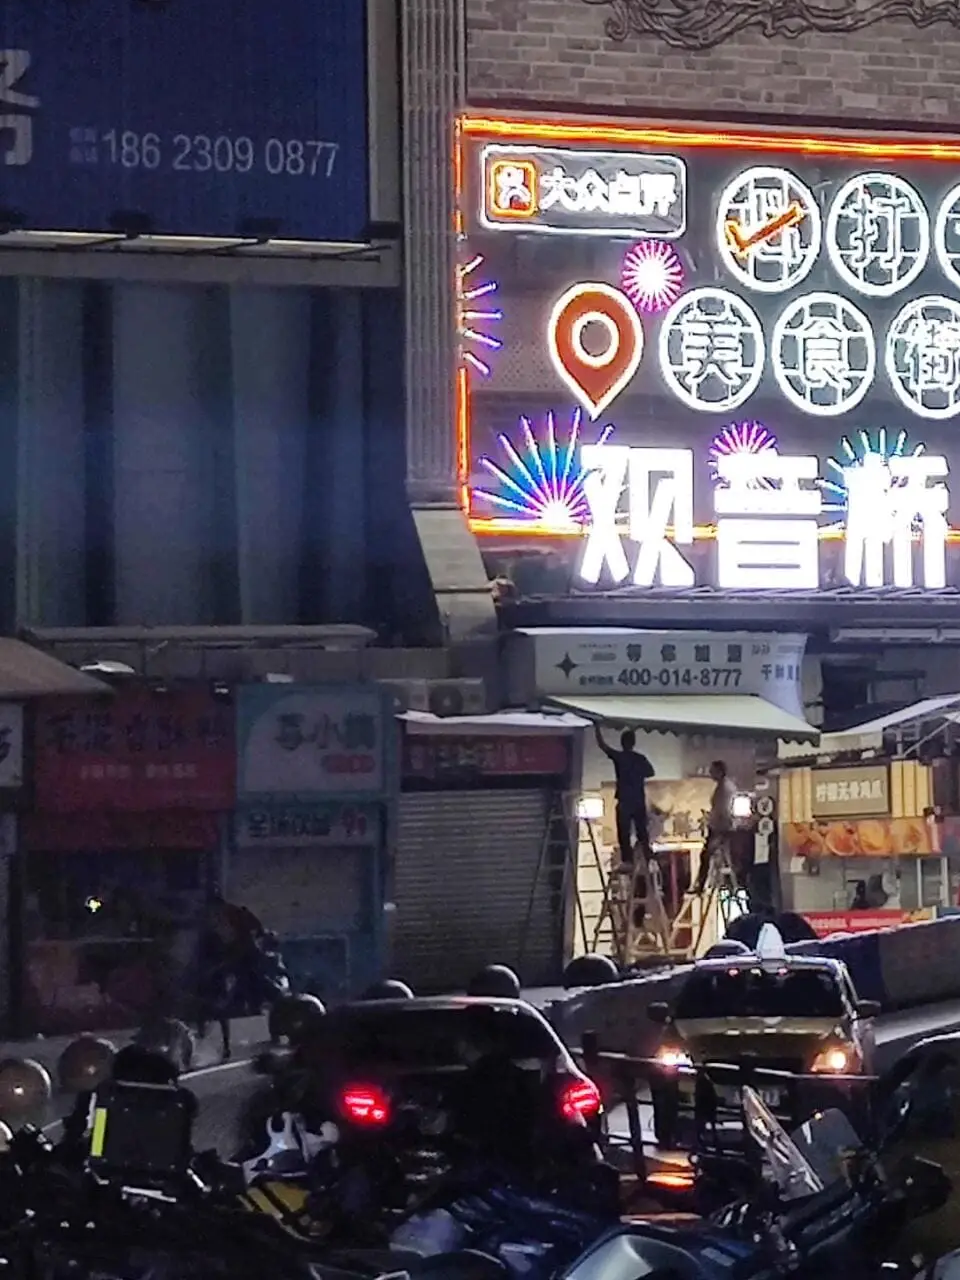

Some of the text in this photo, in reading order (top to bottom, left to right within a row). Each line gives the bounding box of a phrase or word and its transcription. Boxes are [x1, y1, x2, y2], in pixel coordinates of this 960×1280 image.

[103, 128, 162, 169] 186
[172, 133, 255, 174] 2309
[265, 137, 340, 178] 0877
